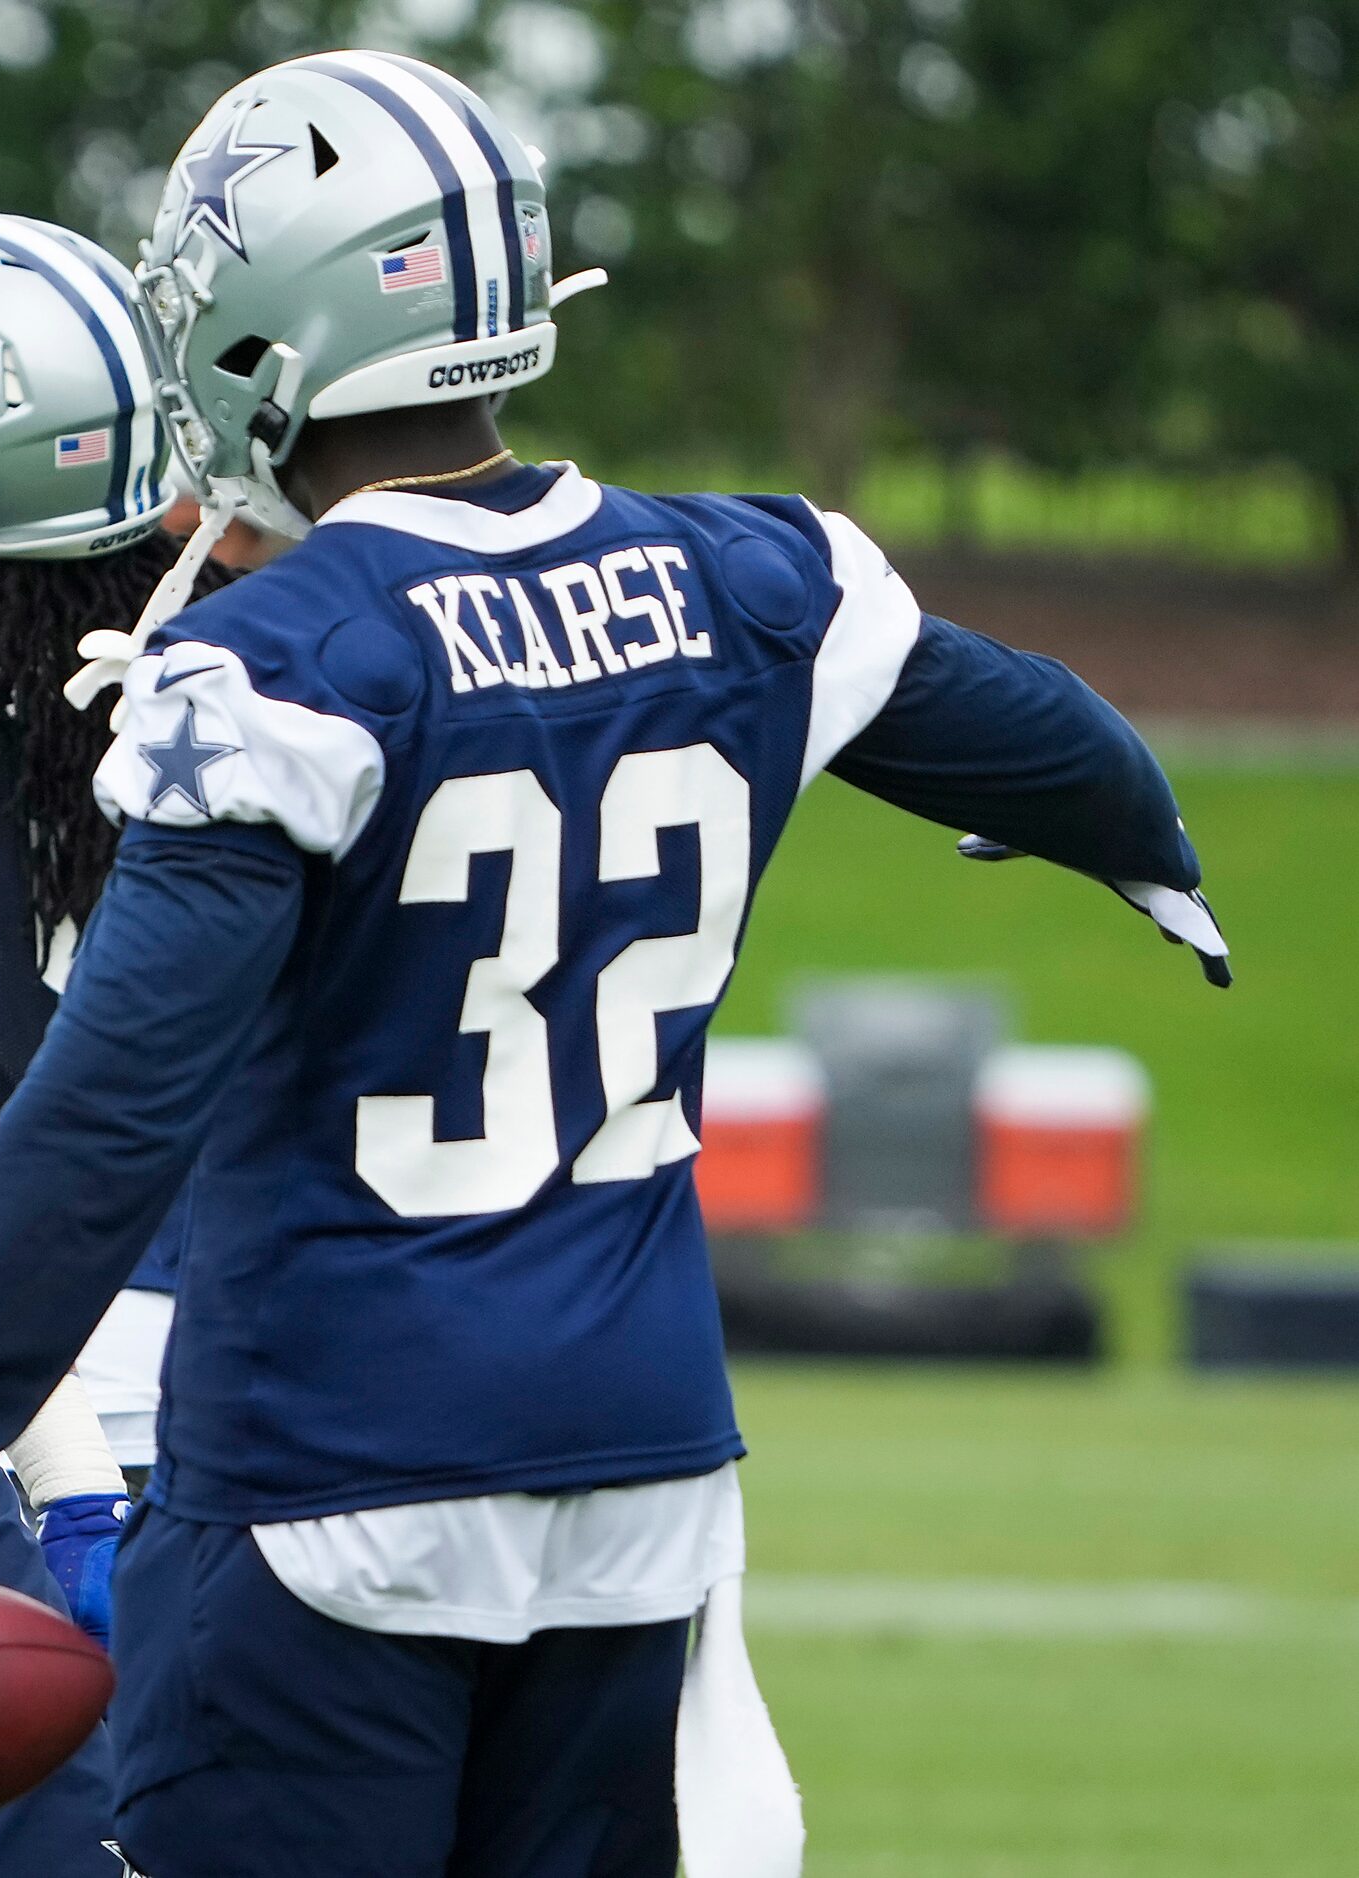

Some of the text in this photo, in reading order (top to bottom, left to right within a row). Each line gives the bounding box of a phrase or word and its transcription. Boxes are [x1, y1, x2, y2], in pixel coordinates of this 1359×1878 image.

[428, 345, 540, 388] COWBOYS
[406, 545, 712, 694] KEARSE
[355, 742, 750, 1217] 32
